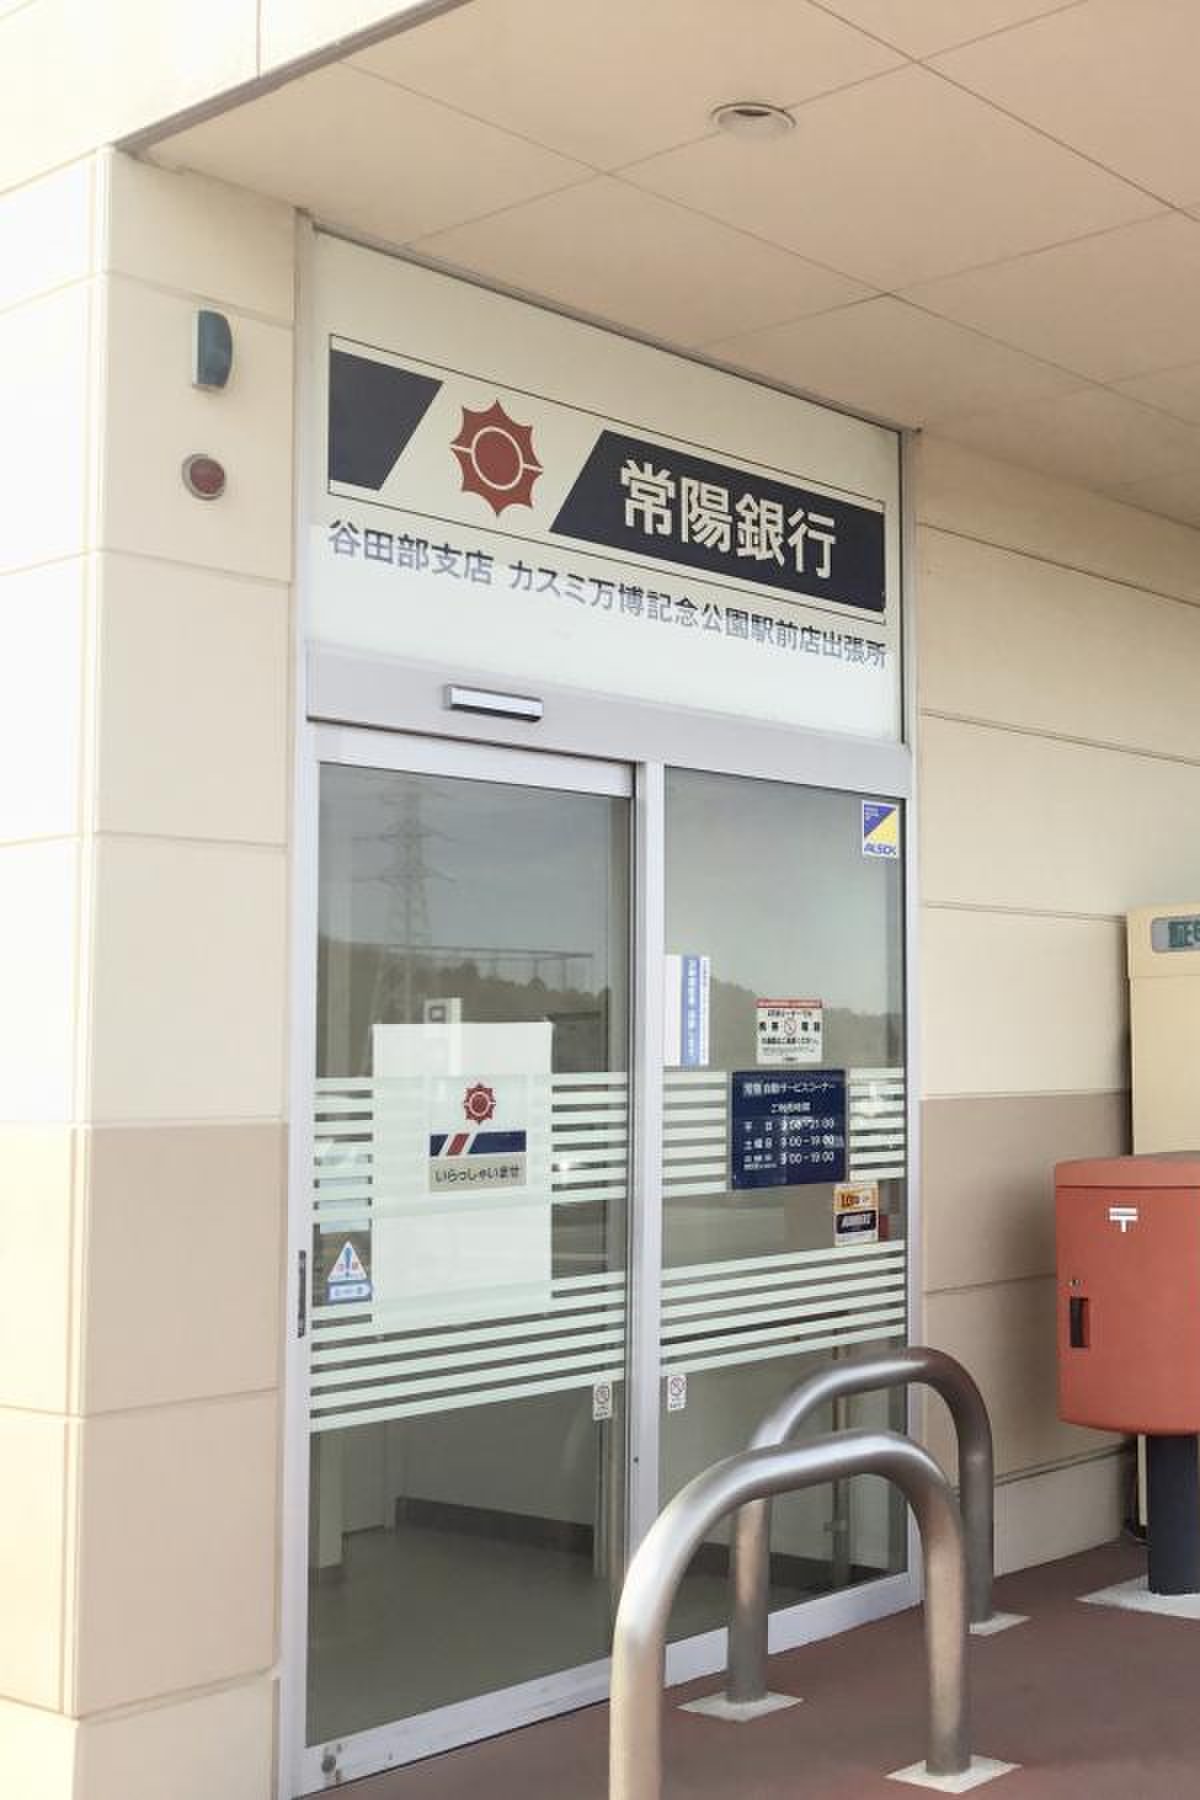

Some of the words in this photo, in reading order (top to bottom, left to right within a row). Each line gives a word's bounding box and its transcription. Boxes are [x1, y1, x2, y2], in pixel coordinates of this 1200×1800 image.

[619, 459, 836, 579] 常陽銀行
[328, 519, 495, 586] 谷田部支店
[508, 559, 887, 668] カスミ万博記念公園駅前店出張所
[434, 1163, 520, 1183] いらっしゃいませ
